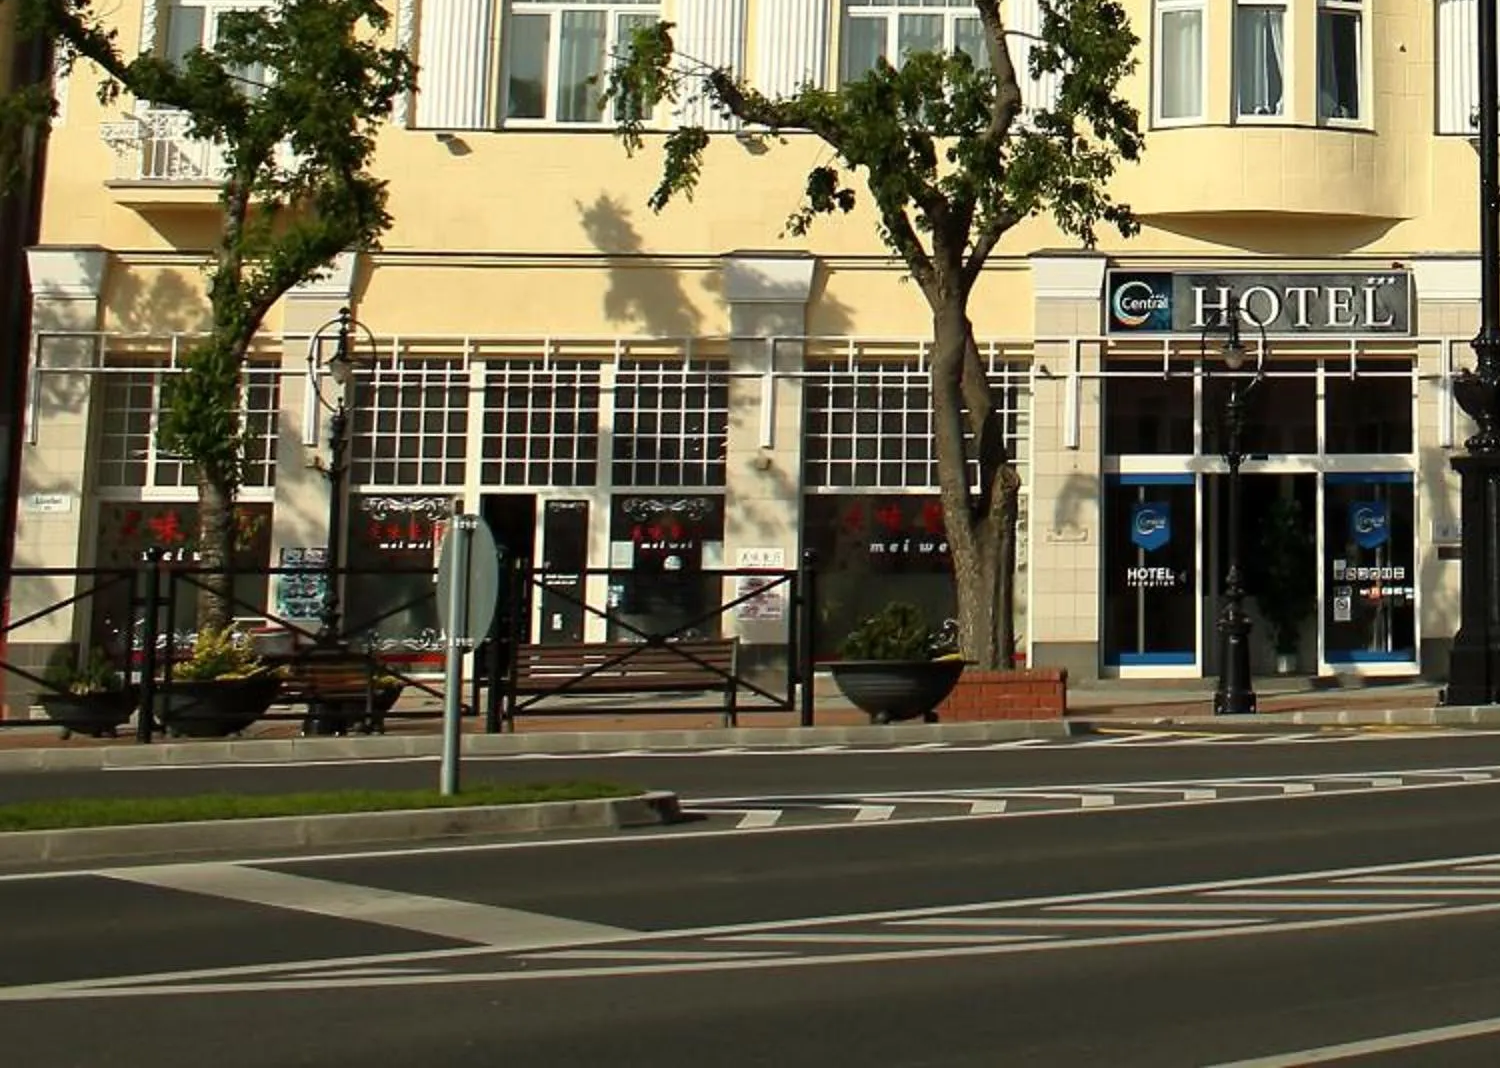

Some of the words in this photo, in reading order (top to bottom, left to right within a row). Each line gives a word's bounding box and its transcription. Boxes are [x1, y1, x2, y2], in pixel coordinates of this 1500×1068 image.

[1121, 295, 1169, 310] Central
[1191, 286, 1393, 327] HOTEL
[869, 538, 909, 553] mei
[918, 541, 948, 553] we
[1127, 567, 1175, 580] HOTEL
